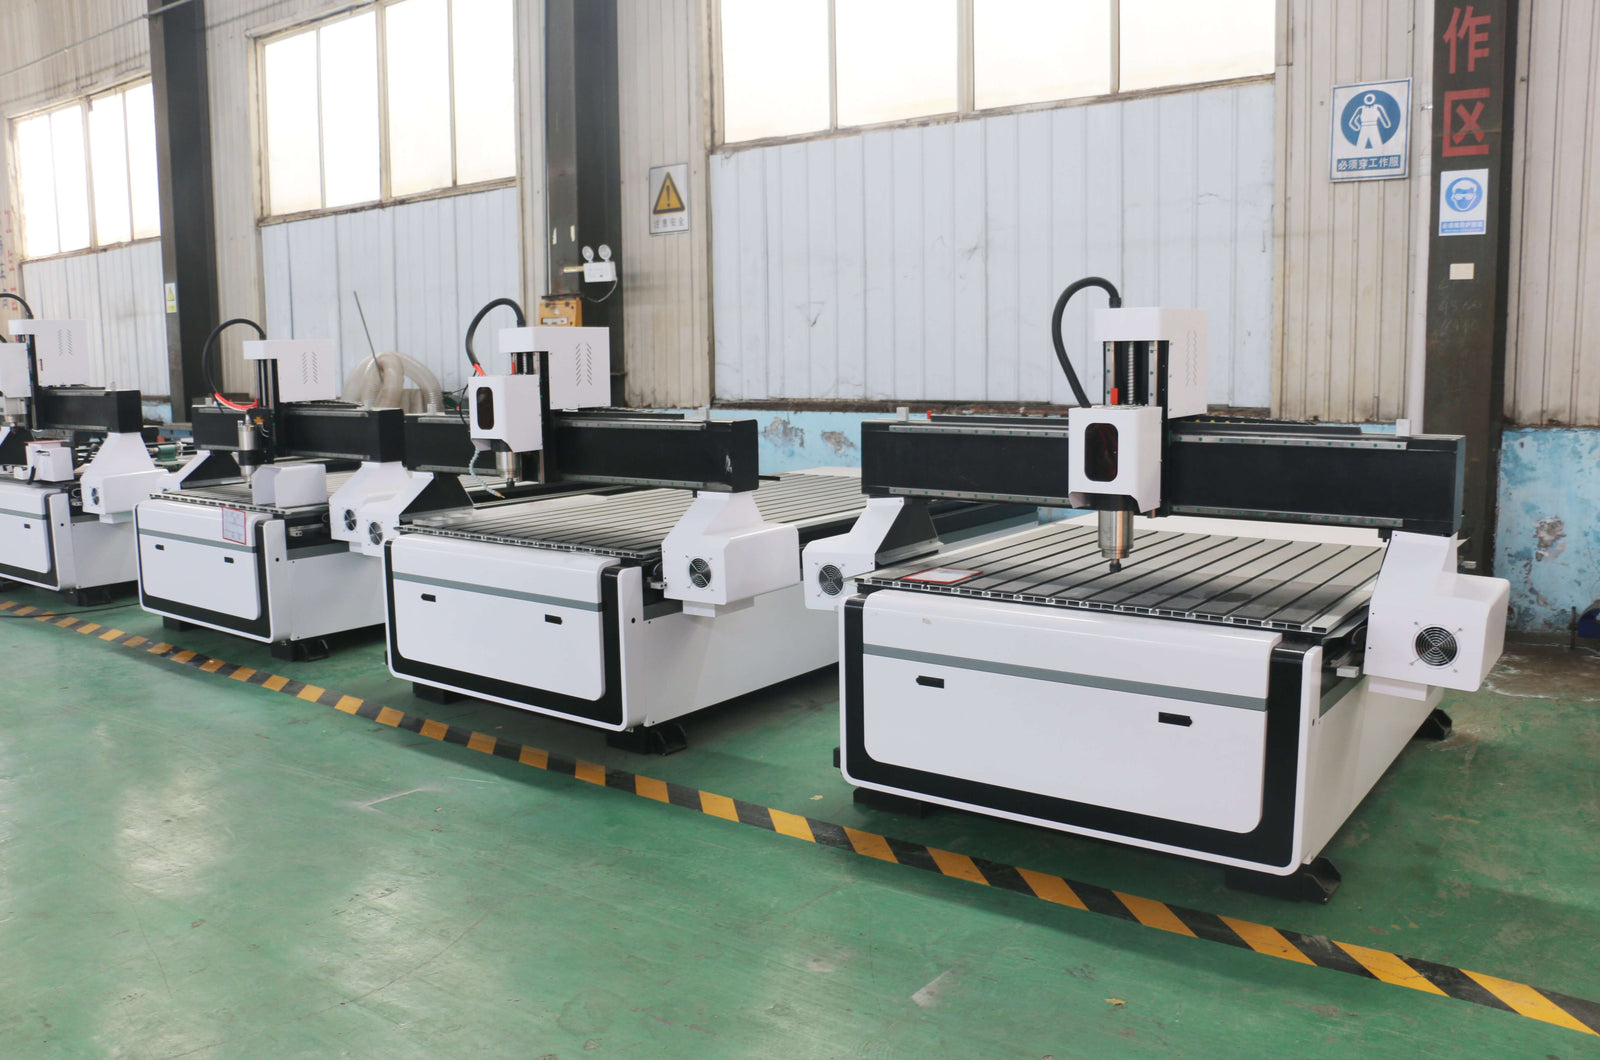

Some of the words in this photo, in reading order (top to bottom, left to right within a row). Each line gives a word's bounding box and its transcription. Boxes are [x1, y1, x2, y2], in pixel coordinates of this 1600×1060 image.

[1442, 5, 1491, 157] 作区
[1338, 156, 1400, 170] 必须穿工作服
